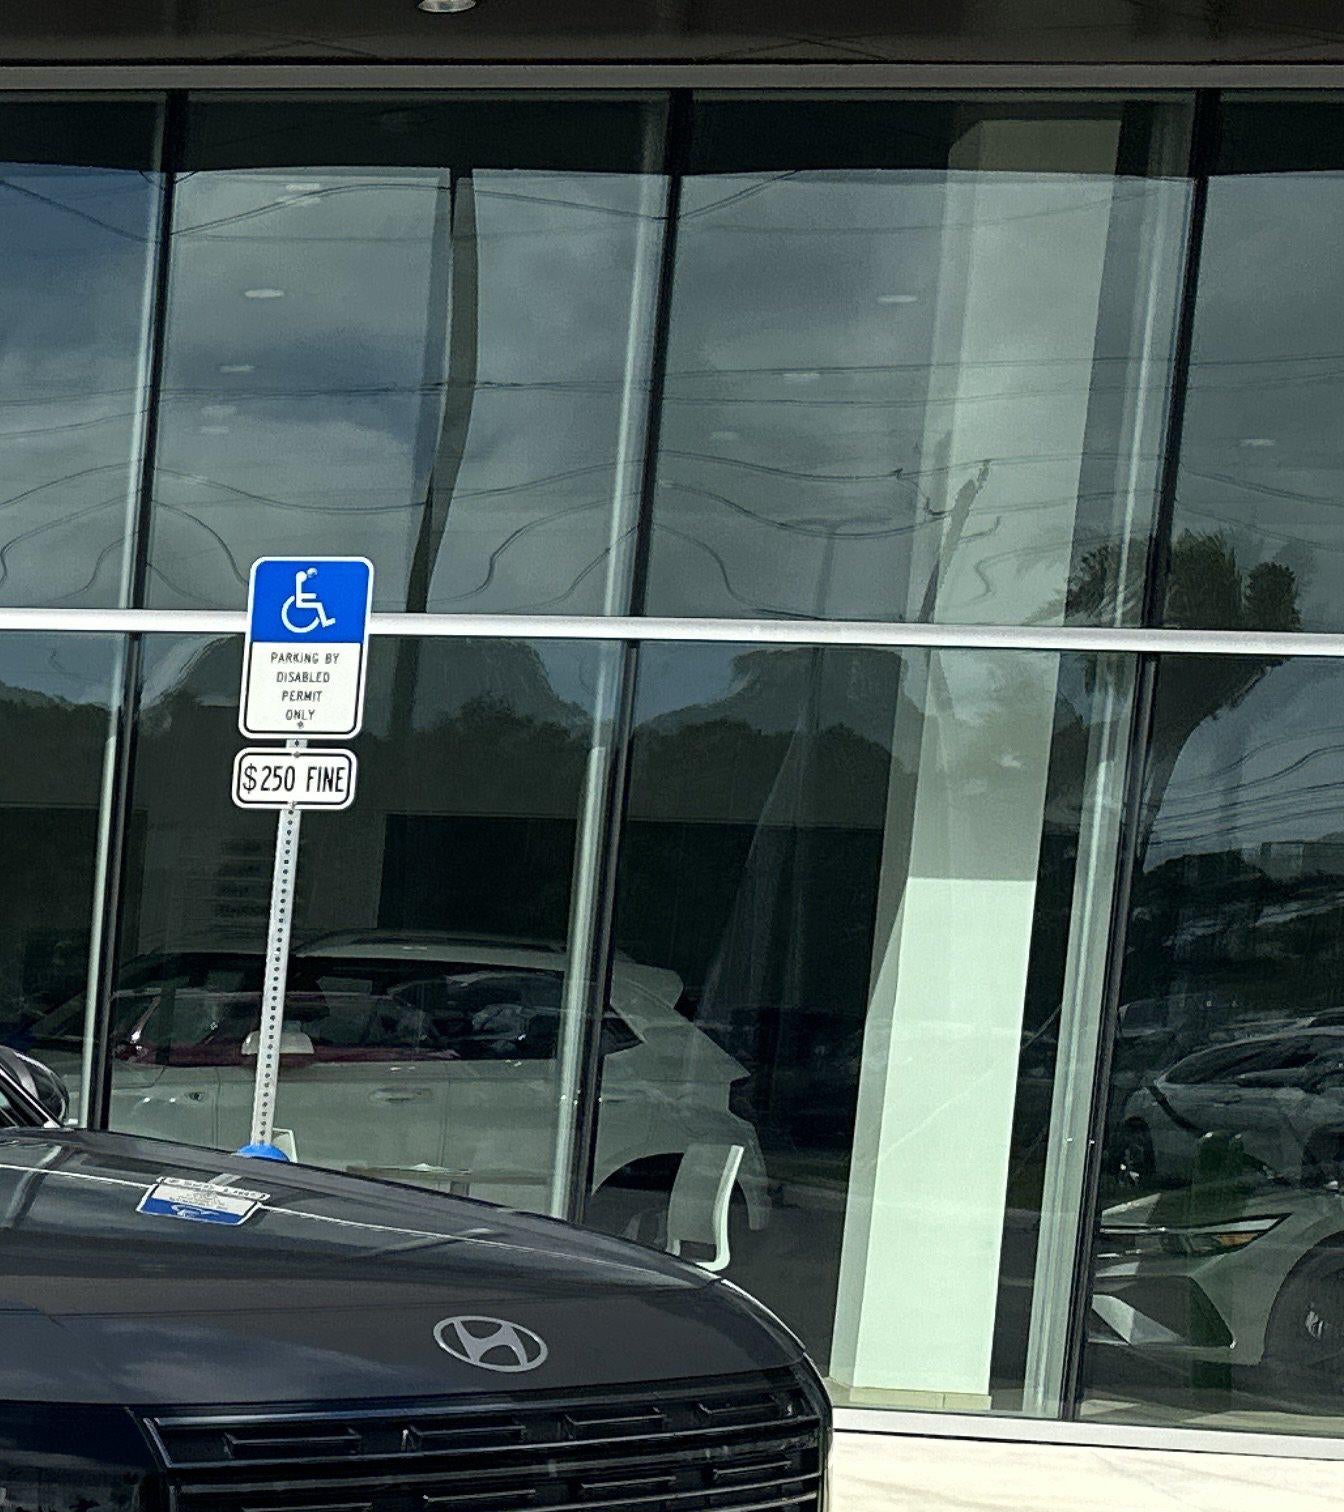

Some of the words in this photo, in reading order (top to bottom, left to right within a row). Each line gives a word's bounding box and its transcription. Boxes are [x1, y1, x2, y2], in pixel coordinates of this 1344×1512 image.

[270, 652, 319, 665] PARKING
[325, 653, 340, 664] BY
[276, 672, 330, 683] DISABLED
[281, 690, 323, 702] PERMIT
[285, 709, 315, 721] ONLY
[242, 763, 296, 794] $250
[306, 766, 345, 793] FINE
